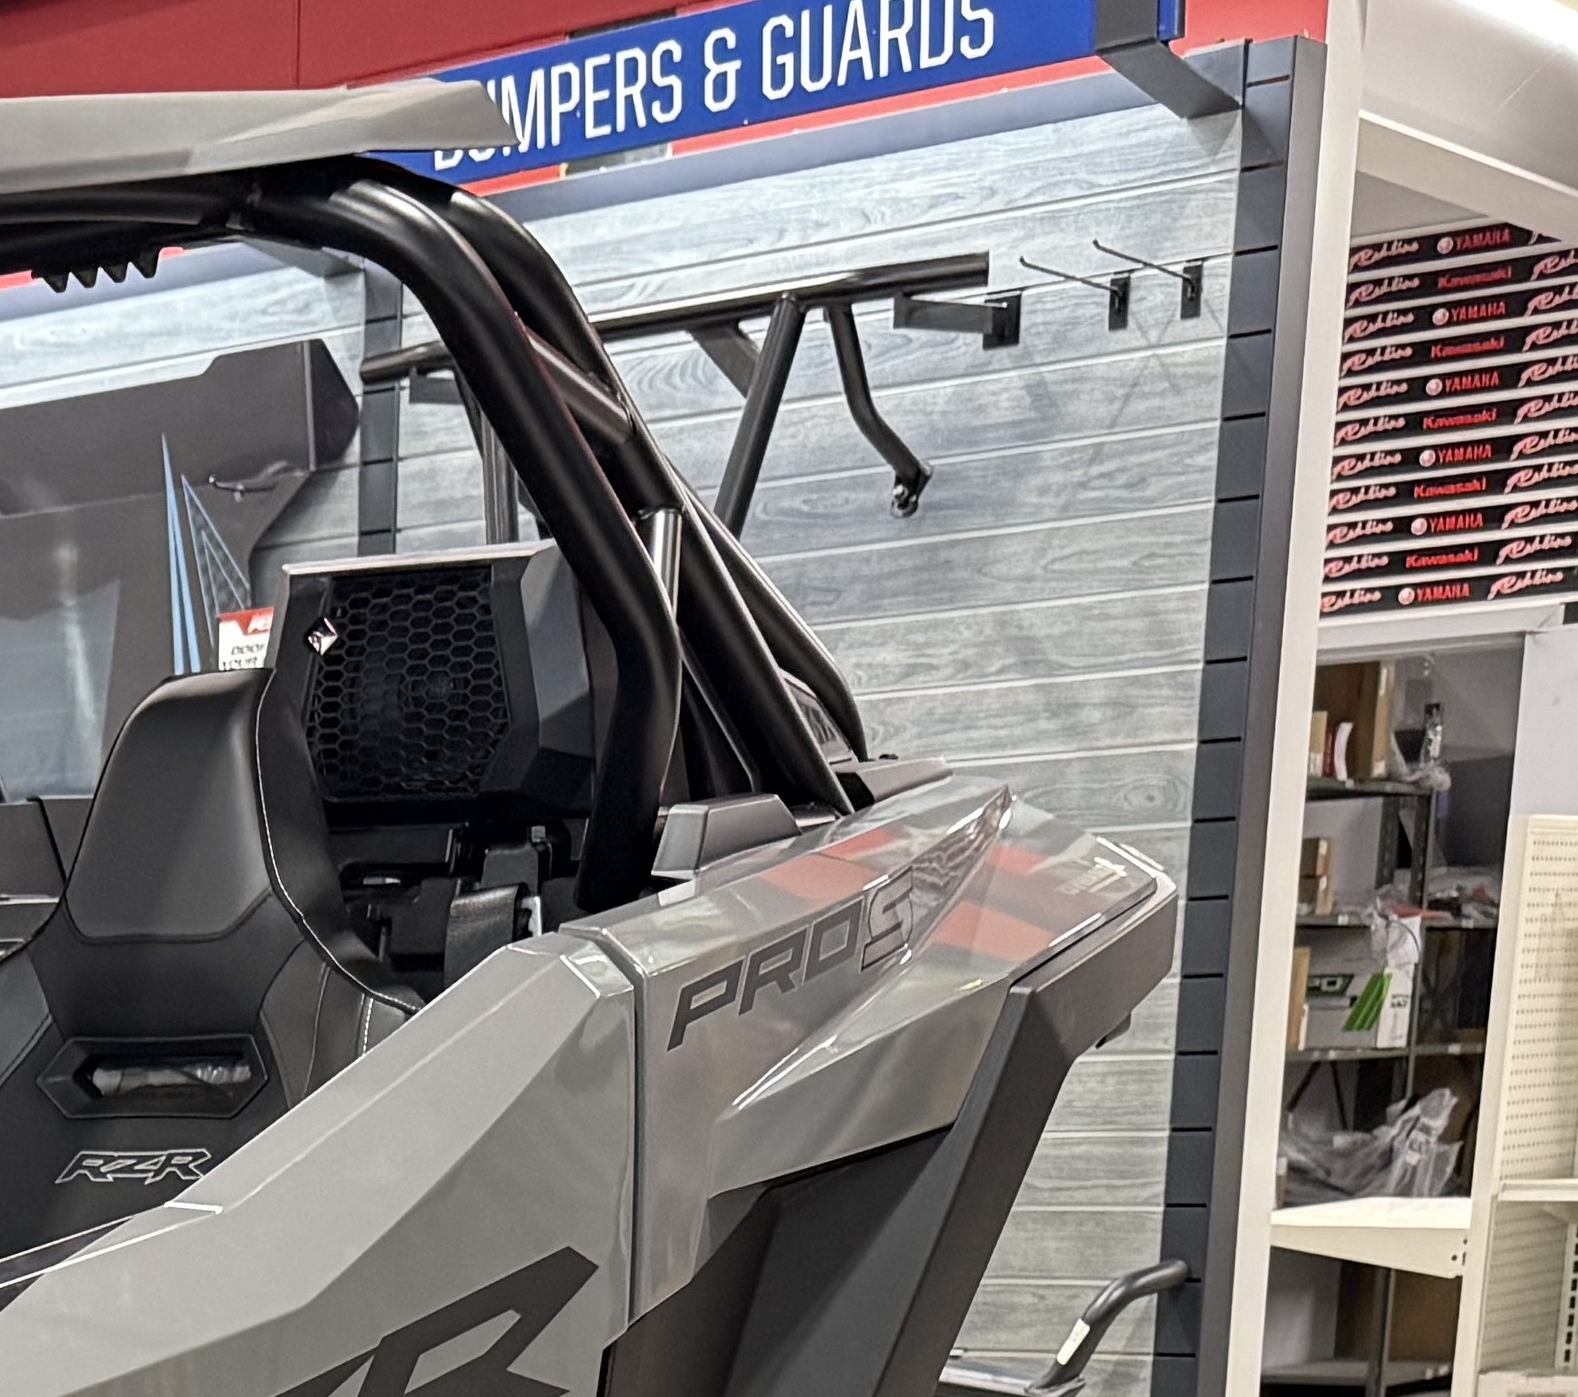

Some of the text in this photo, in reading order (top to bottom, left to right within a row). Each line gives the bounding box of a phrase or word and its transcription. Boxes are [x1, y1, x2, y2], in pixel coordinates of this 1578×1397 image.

[433, 0, 996, 170] MPERS & GUARDS
[1456, 228, 1511, 245] YAMAHA
[1451, 302, 1506, 322] YAMAHA
[1445, 371, 1500, 391] YAMAHA
[1438, 444, 1492, 463] YAMAHA
[1430, 513, 1483, 532] YAMAHA
[1416, 583, 1470, 601] YAMAHA
[667, 895, 866, 1052] PRO
[54, 1148, 212, 1186] RZR
